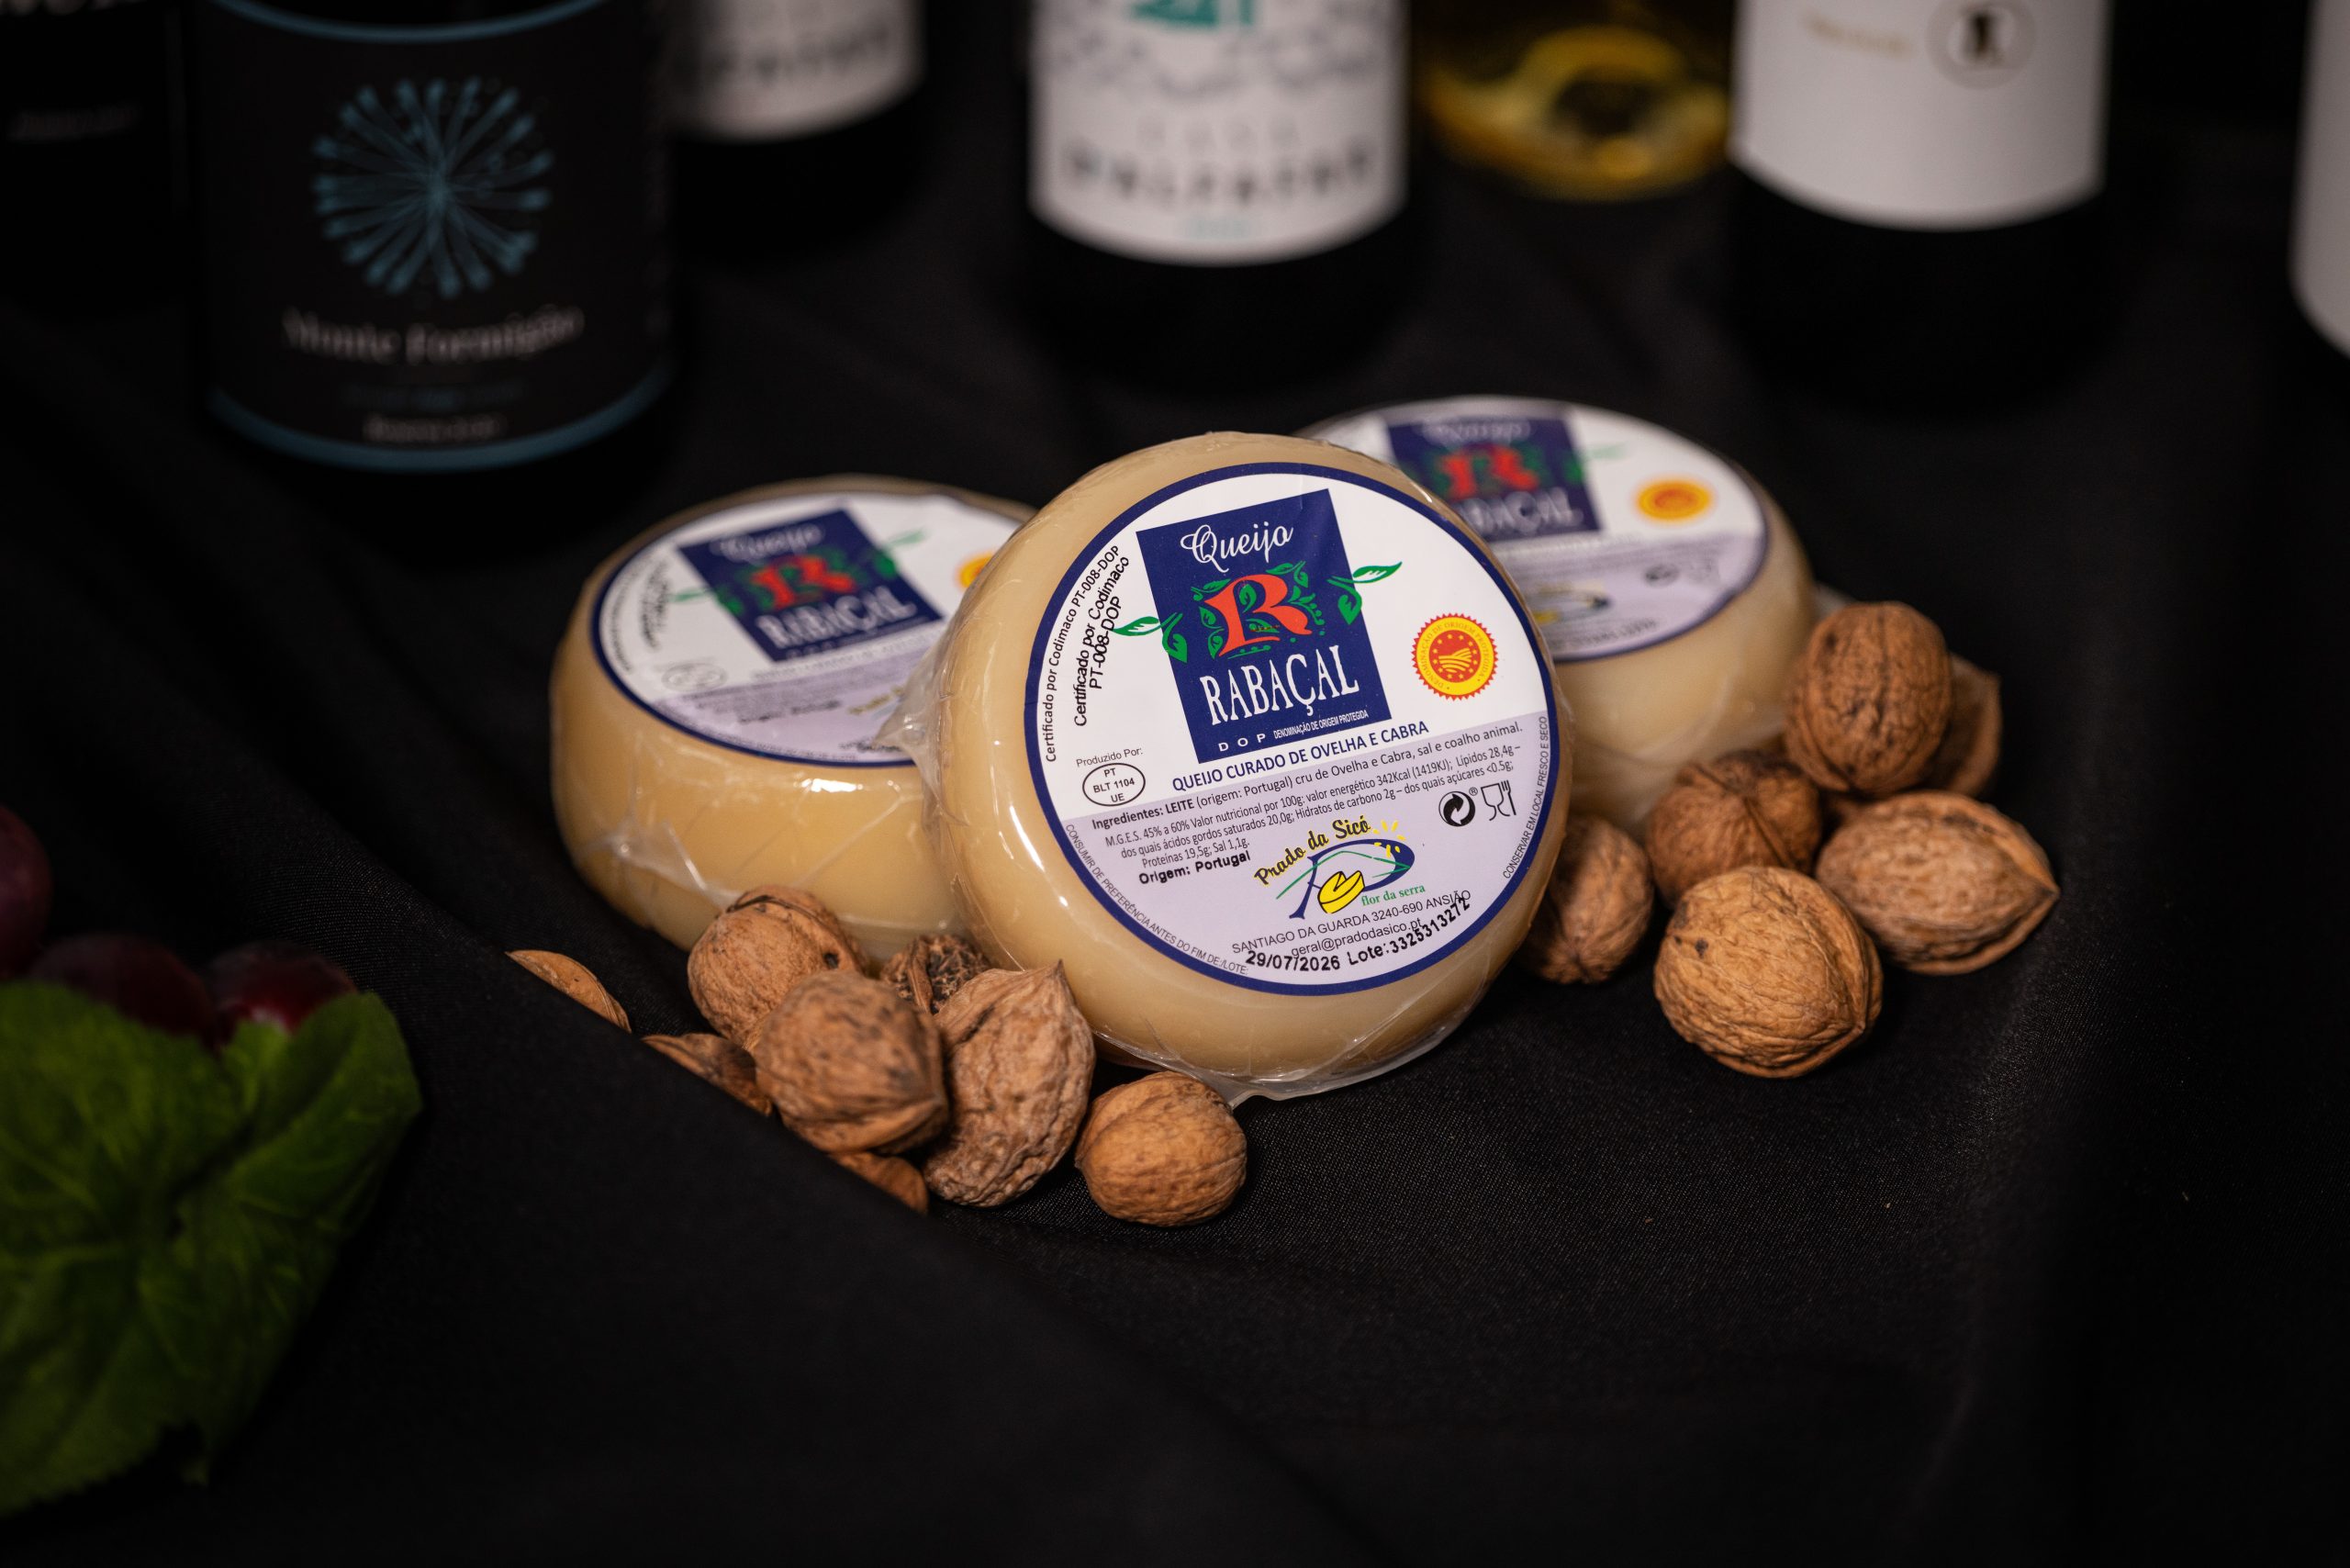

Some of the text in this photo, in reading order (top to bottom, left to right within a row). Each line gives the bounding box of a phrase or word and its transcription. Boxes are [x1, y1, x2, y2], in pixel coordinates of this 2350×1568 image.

[1180, 521, 1293, 573] Queijo
[1203, 574, 1313, 657] R
[1042, 545, 1119, 762] Certificado por Codimaco PT-008-DOP
[1073, 556, 1129, 726] Certificado por Codimaco
[1089, 596, 1122, 689] PT-008-DOP
[1199, 644, 1360, 725] RABAÇAL
[1273, 722, 1311, 739] DENOMINAÇÃO
[1311, 721, 1319, 732] DE
[1319, 716, 1339, 729] ORIGEM
[1339, 710, 1370, 724] PROTEGIDA
[1539, 716, 1549, 741] SECO
[1076, 747, 1143, 767] Produzido Por:
[1092, 721, 1523, 830] Ingredientes: LEITE (origem: Portugal) cru de Ovelha e Cabra, sal e coalho animal.
[1103, 767, 1116, 778] PT
[1172, 721, 1429, 791] QUEIJO CURADO DE OVELHA E CABRA
[1537, 751, 1549, 788] FRESCO
[1092, 778, 1136, 794] BLT 1104
[1105, 831, 1142, 847] M.G.E.S.
[1143, 825, 1162, 839] 45%
[1163, 826, 1169, 834] a
[1170, 820, 1191, 834] 60%
[1190, 814, 1214, 829] Valor
[1215, 803, 1262, 823] nutricional
[1263, 801, 1279, 813] por
[1305, 790, 1327, 802] valor
[1329, 779, 1375, 797] energético
[1377, 768, 1411, 786] 342Kcal
[1456, 752, 1487, 767] Lípidos
[1488, 745, 1515, 759] 28,4g
[1111, 793, 1125, 803] UE
[1530, 790, 1544, 816] LOCAL
[1121, 847, 1137, 858] dos
[1138, 843, 1162, 857] quais
[1163, 834, 1192, 851] ácidos
[1192, 829, 1223, 846] gordos
[1224, 817, 1267, 836] saturados
[1295, 802, 1333, 820] Hidratos
[1334, 800, 1345, 811] de
[1347, 792, 1382, 808] carbono
[1384, 789, 1396, 800] 2g
[1404, 782, 1420, 794] dos
[1422, 776, 1446, 791] quais
[1447, 767, 1485, 785] açúcares
[1526, 816, 1536, 831] EM
[1138, 850, 1251, 884] Origem: Portugal
[1142, 853, 1183, 868] Proteínas
[1213, 840, 1227, 853] Sal
[1254, 814, 1371, 886] Prado da Sicó
[1503, 830, 1532, 879] CONSERVAR
[1066, 824, 1096, 868] CONSUMIR
[1091, 867, 1104, 881] DE
[1149, 924, 1177, 945] ANTES
[1176, 939, 1191, 952] DO
[1191, 947, 1207, 959] FIM
[1360, 884, 1426, 907] flor da serra
[1232, 890, 1471, 953] SANTIAGO DA GUARDA 3240-690 ANSIÃO
[1291, 917, 1423, 958] geral@pradodasico.pt
[1245, 950, 1340, 971] 29/07/2026
